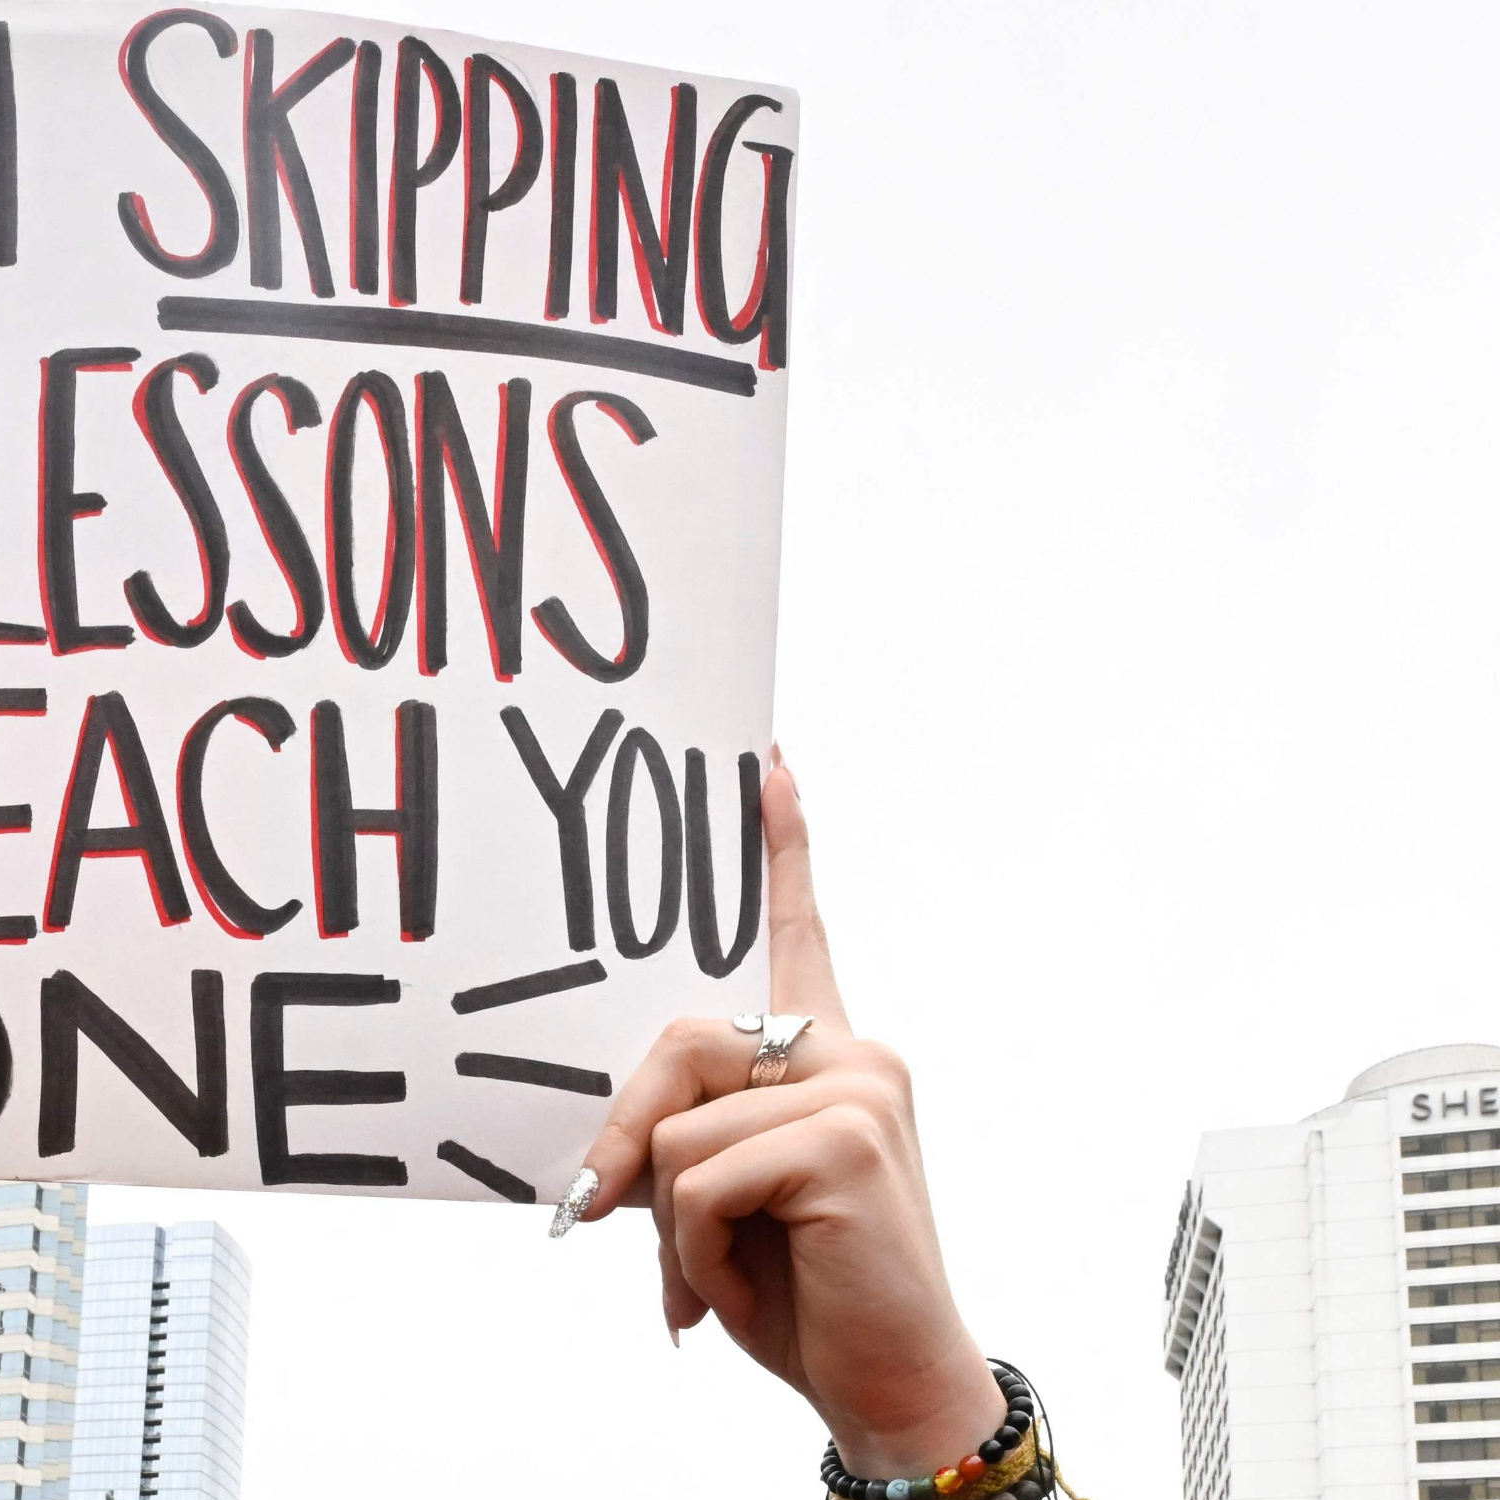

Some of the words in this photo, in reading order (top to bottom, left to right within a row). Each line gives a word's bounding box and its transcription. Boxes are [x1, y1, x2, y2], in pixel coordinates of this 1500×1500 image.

[117, 8, 794, 371] SKIPPING
[500, 708, 762, 978] YOU
[1411, 1087, 1499, 1121] SHE
